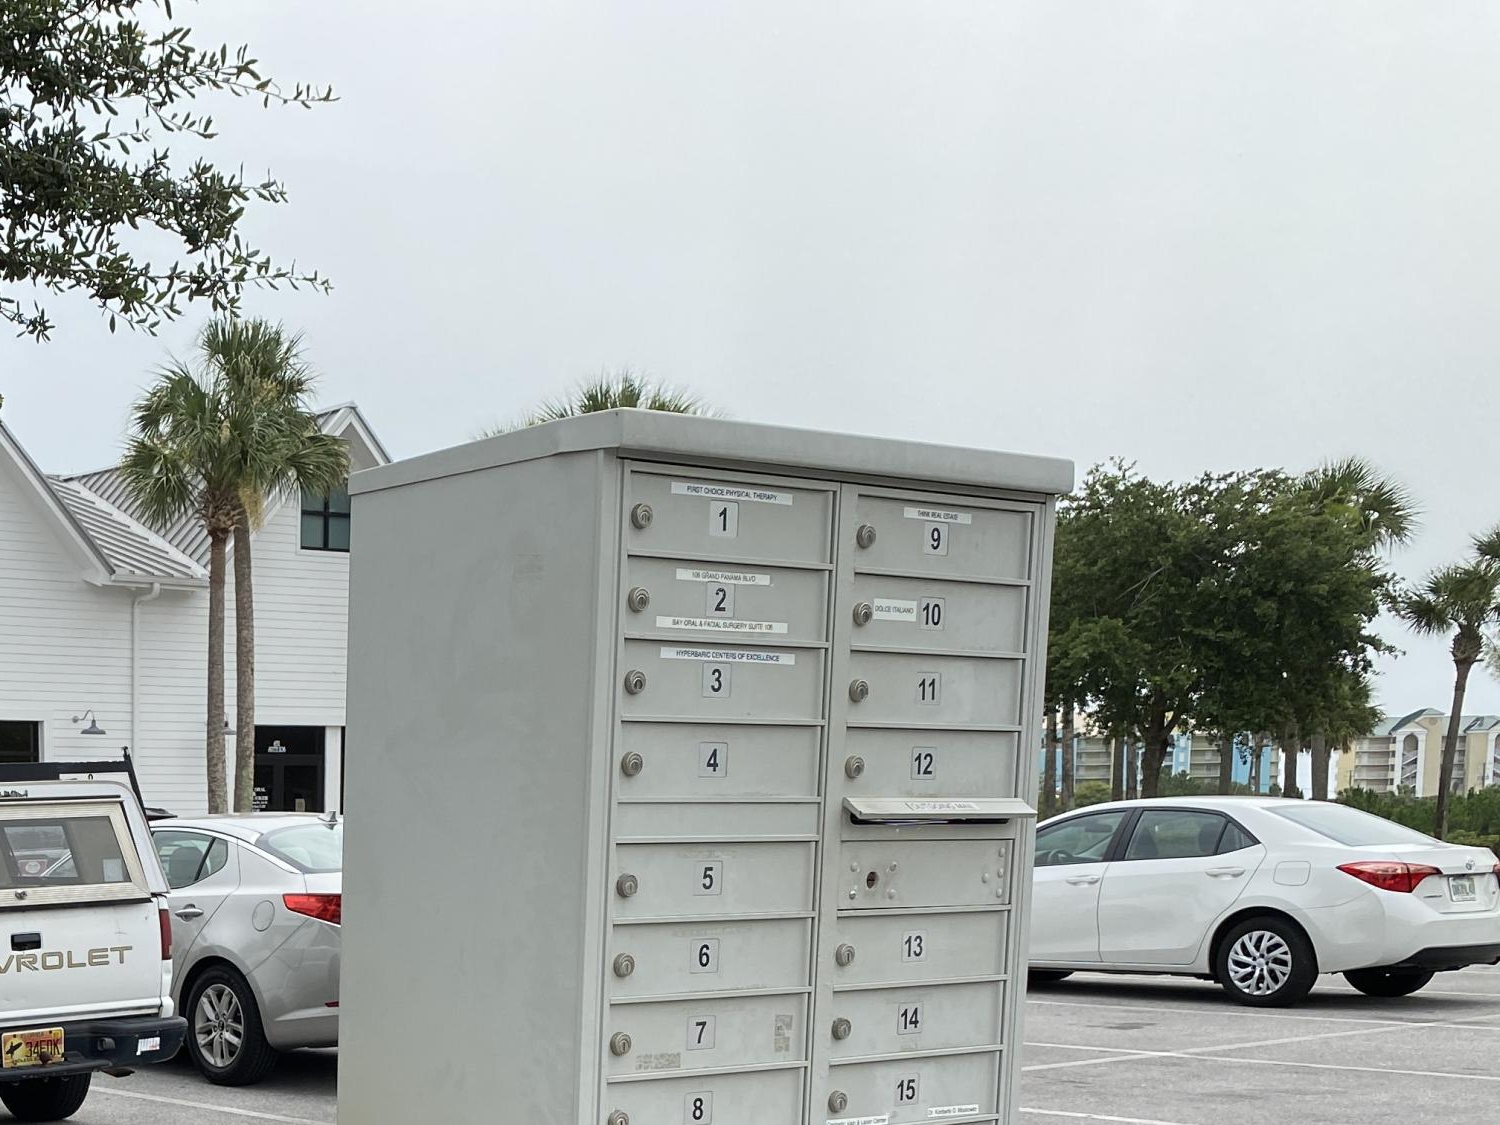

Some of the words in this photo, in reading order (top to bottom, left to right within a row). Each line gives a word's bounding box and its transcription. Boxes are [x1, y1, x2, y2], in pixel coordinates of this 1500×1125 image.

[704, 487, 725, 496] CHOICE
[726, 489, 752, 498] PHYSICAL
[753, 492, 778, 500] THERAPY
[718, 506, 728, 532] 1
[931, 511, 942, 519] REAL
[930, 526, 942, 550] 9
[720, 573, 741, 581] PANAMA
[714, 587, 727, 612] 2
[684, 619, 698, 627] ORAL
[722, 621, 747, 630] SURGERY
[922, 602, 941, 626] 10
[676, 649, 711, 658] HYPERBARIC
[712, 651, 737, 660] CENTERS
[737, 652, 745, 660] OF
[746, 653, 780, 662] EXCELLENCE
[710, 668, 722, 693] 3
[918, 677, 937, 701] 11
[706, 748, 719, 772] 4
[914, 752, 933, 775] 12
[701, 866, 714, 890] 5
[698, 943, 710, 967] 6
[904, 935, 923, 958] 13
[900, 1007, 919, 1030] 14
[695, 1020, 707, 1044] 7
[896, 1078, 916, 1101] 15
[692, 1097, 704, 1121] 8
